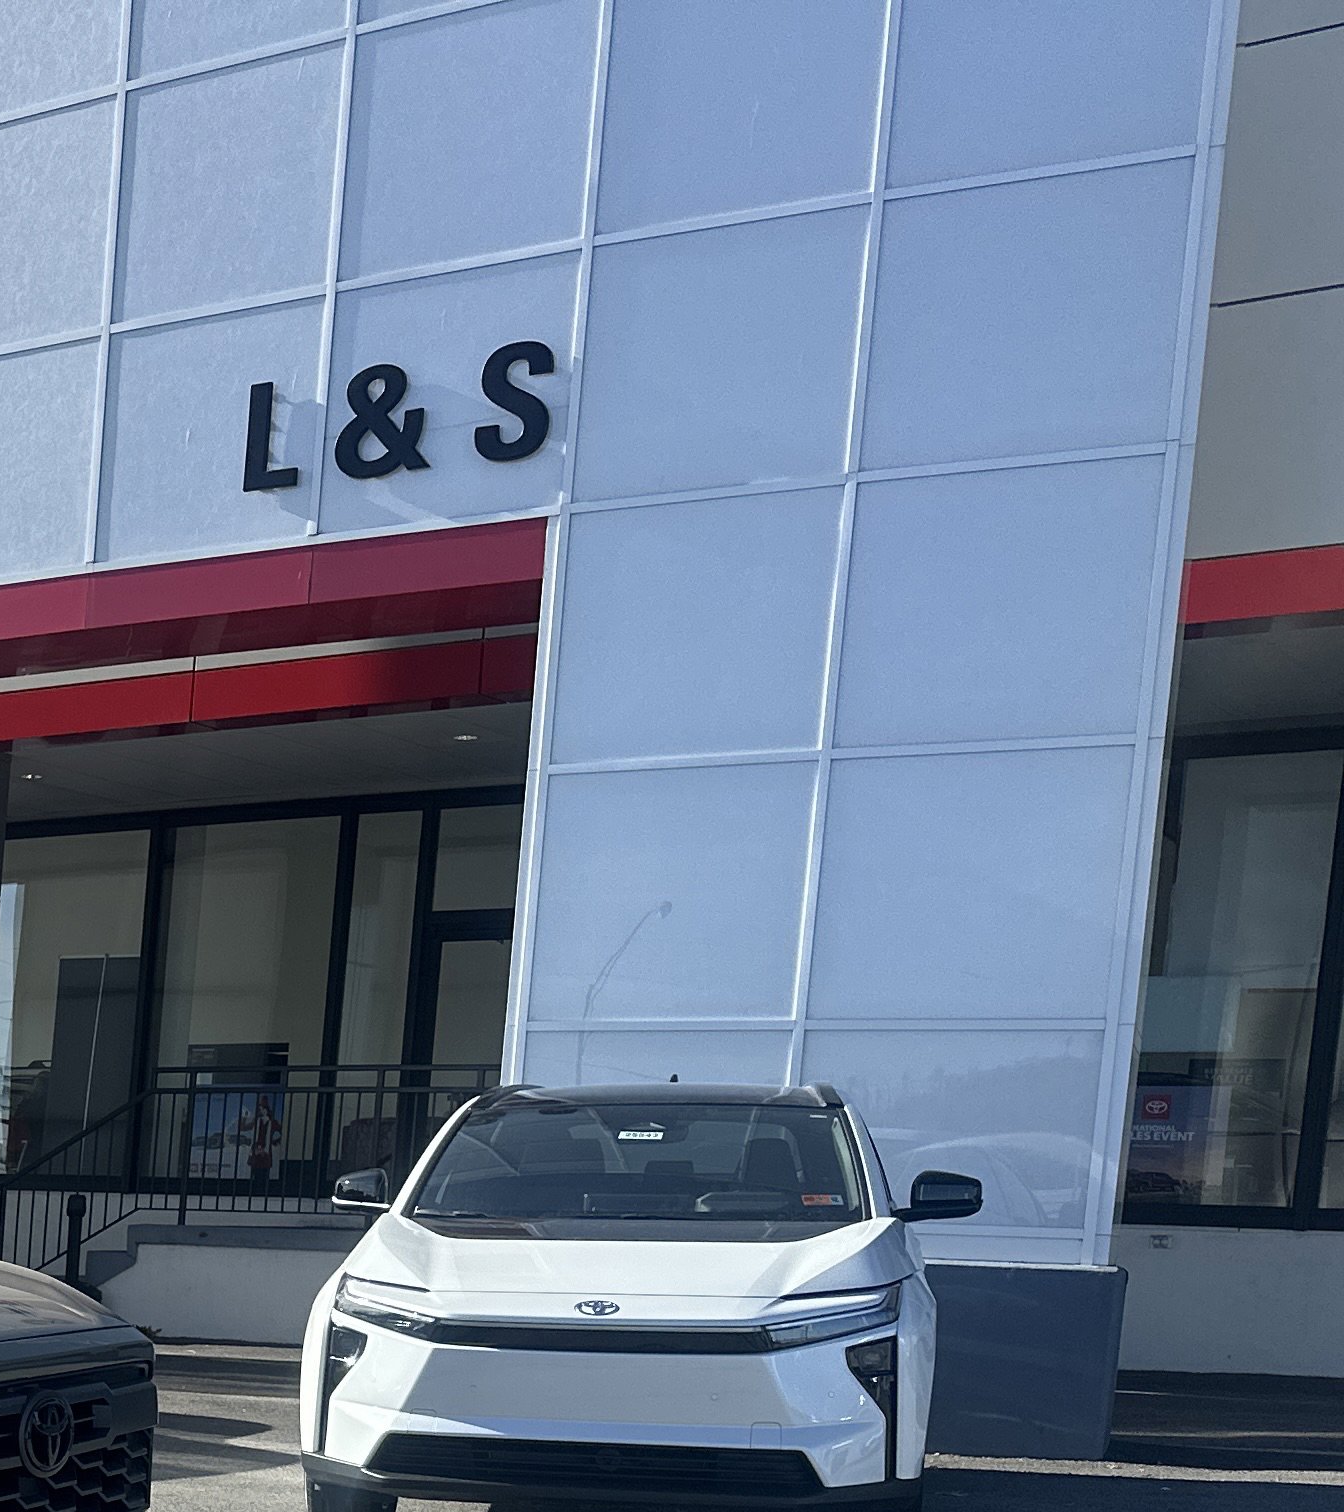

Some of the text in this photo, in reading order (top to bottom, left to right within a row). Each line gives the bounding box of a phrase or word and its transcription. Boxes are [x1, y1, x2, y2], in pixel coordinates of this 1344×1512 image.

[243, 340, 555, 493] L & S
[1153, 1131, 1195, 1142] EVENT
